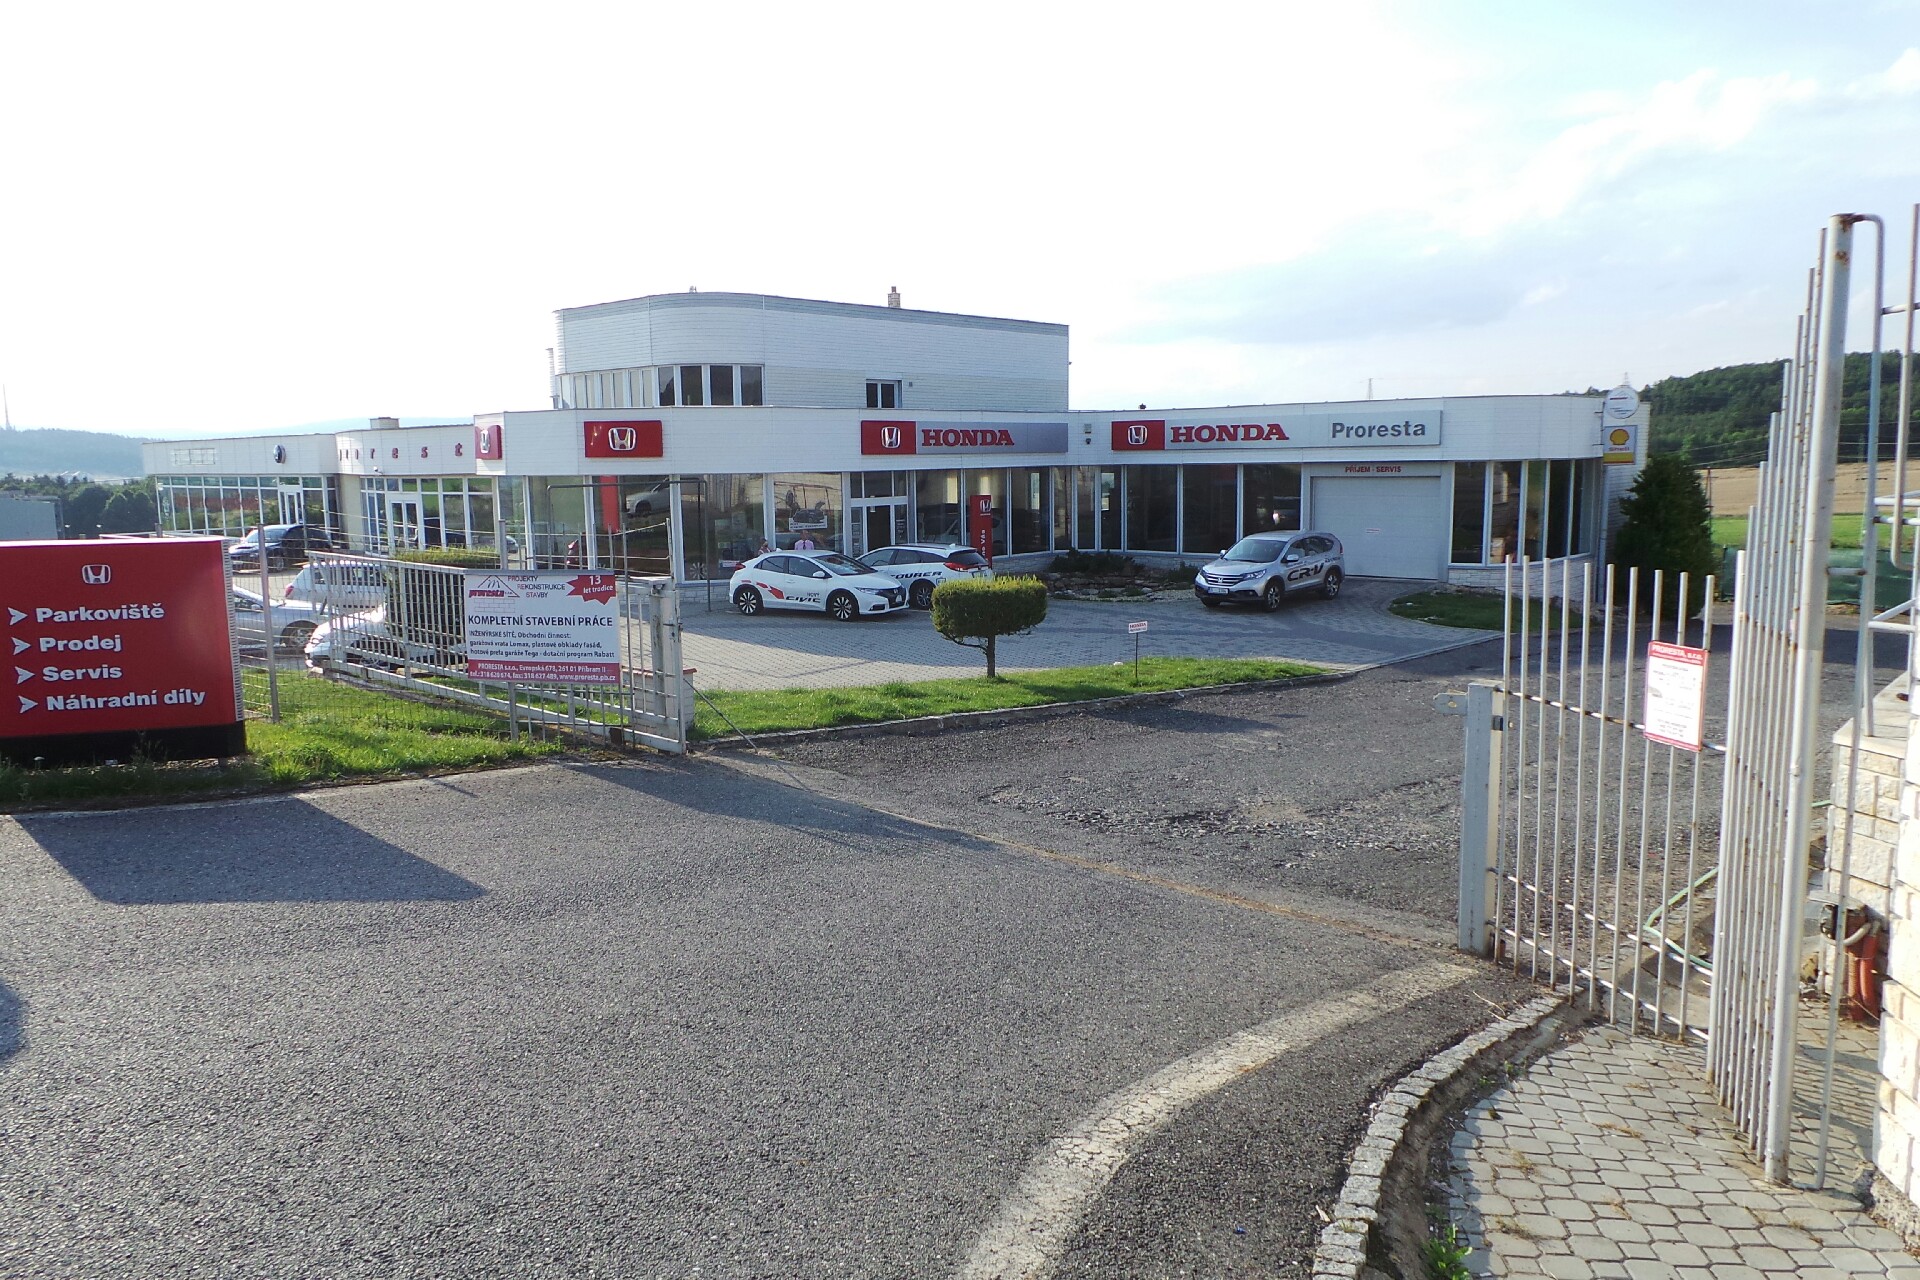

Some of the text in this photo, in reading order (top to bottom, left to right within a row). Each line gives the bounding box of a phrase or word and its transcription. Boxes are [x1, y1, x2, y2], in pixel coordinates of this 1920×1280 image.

[1170, 423, 1290, 443] HONDA
[1331, 420, 1427, 439] Proresta
[921, 428, 1015, 447] HONDA
[589, 575, 602, 586] 13
[592, 584, 614, 592] tradice
[525, 591, 549, 599] STAVBY
[786, 595, 821, 604] CIVIC
[36, 603, 165, 622] Parkoviště
[468, 614, 613, 626] KOMPLETNÍ STAVEBNÍ PRÁCE
[40, 635, 122, 652] Prodej
[557, 641, 583, 649] obklady
[566, 651, 593, 659] program
[42, 664, 123, 682] Servis
[477, 663, 504, 671] PRORESTA
[46, 688, 206, 711] Náhradní díly
